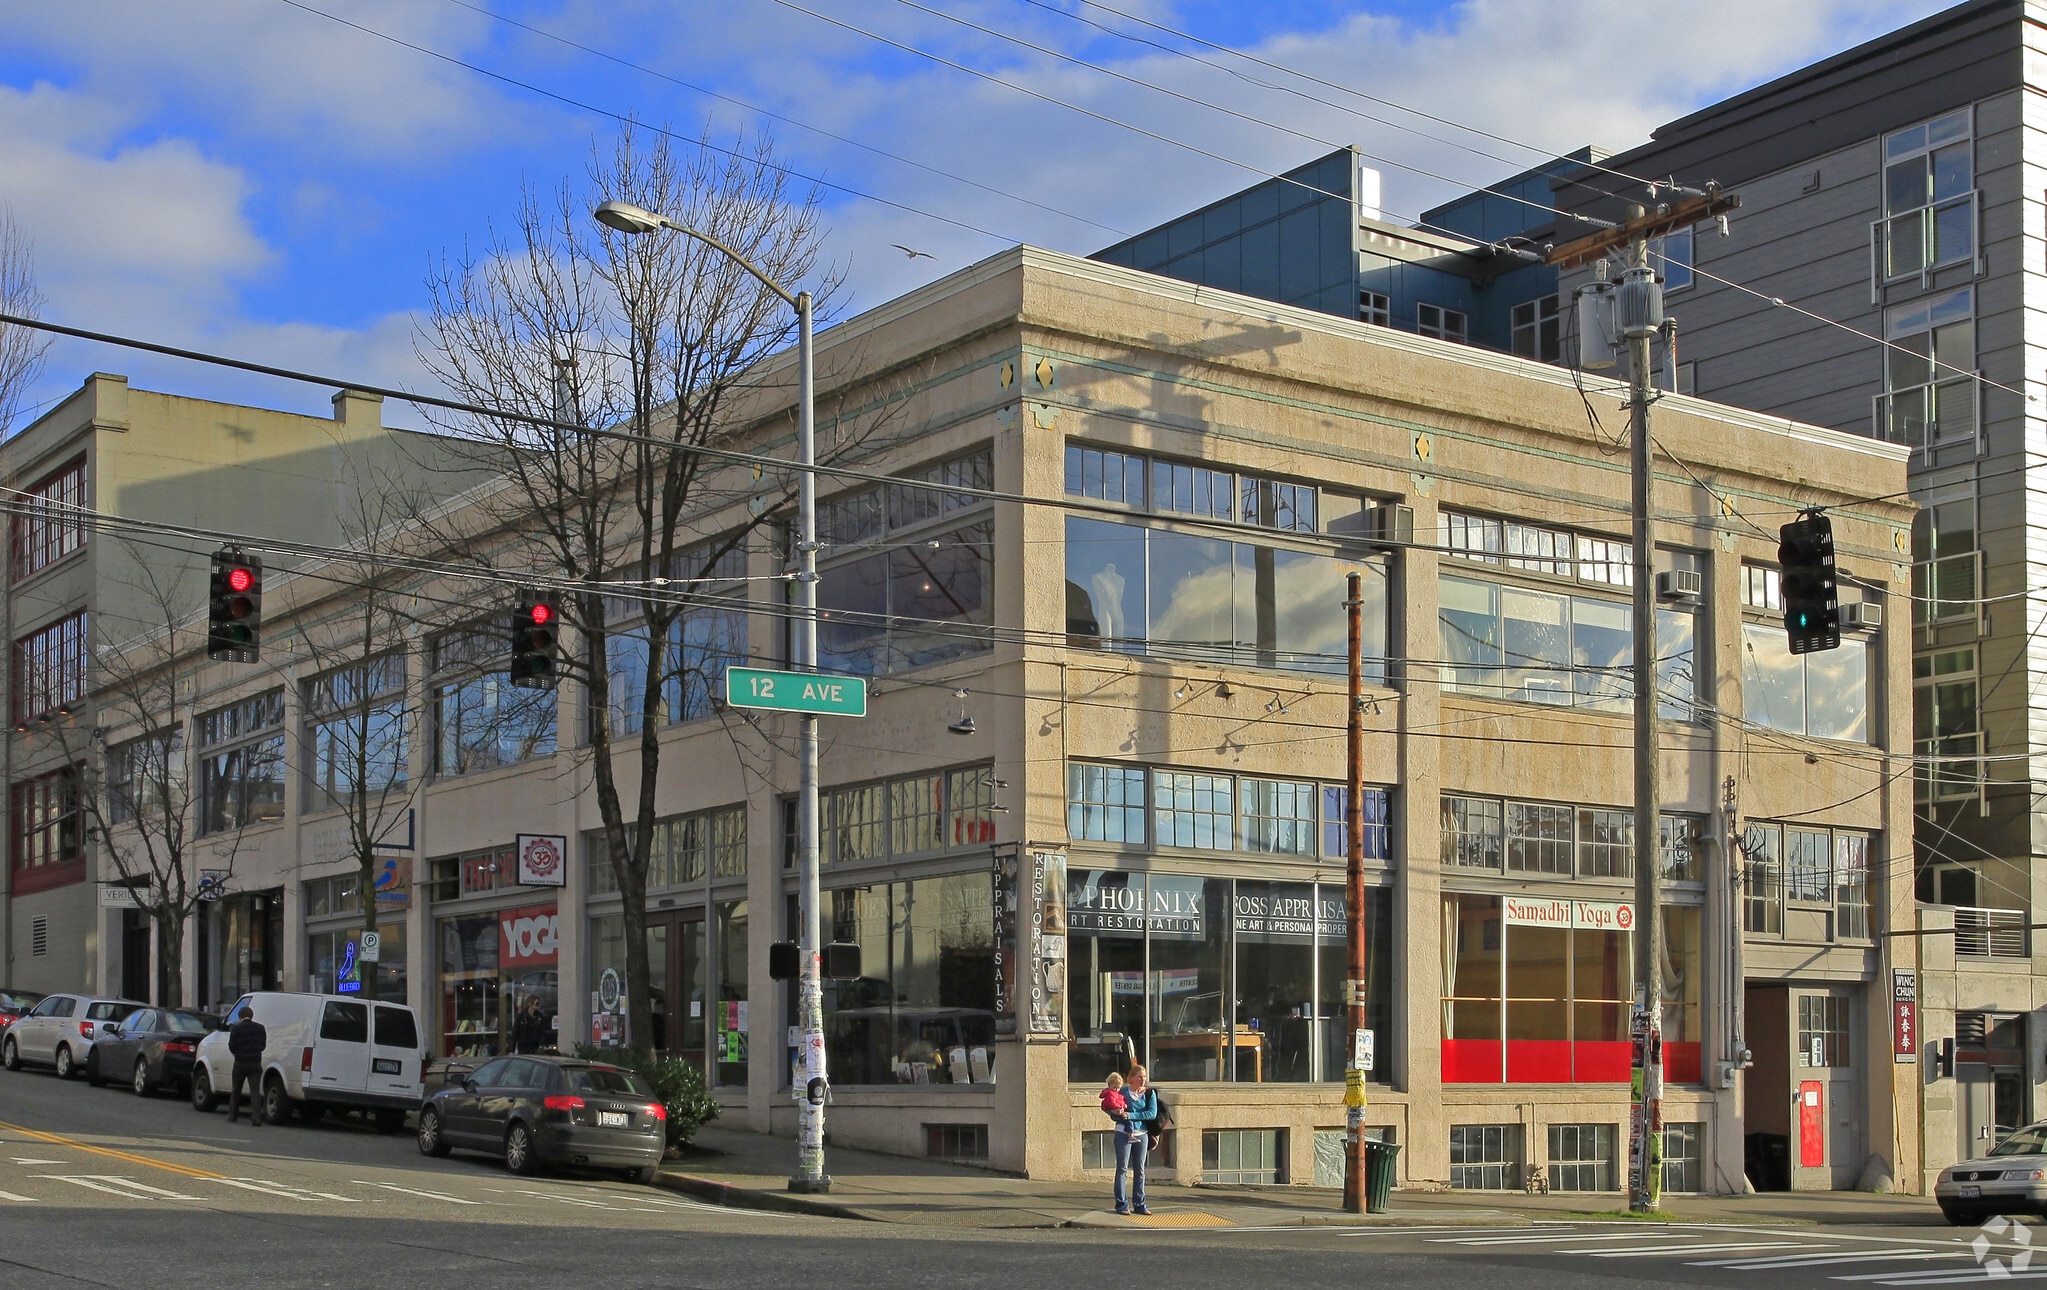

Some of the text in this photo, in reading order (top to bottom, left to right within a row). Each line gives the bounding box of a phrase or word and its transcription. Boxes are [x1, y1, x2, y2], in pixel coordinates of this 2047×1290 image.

[751, 677, 842, 702] 12 AVE
[1084, 885, 1200, 914] PHOENIX
[1507, 898, 1612, 929] Samadhi Yoga
[502, 914, 558, 957] YOGA
[993, 857, 1004, 1012] APPRAISALS
[1031, 853, 1044, 1015] RESTORATION
[1097, 915, 1200, 931] RESTORATION
[1249, 920, 1264, 931] ART
[1266, 921, 1273, 931] &
[1895, 986, 1914, 997] CHUN
